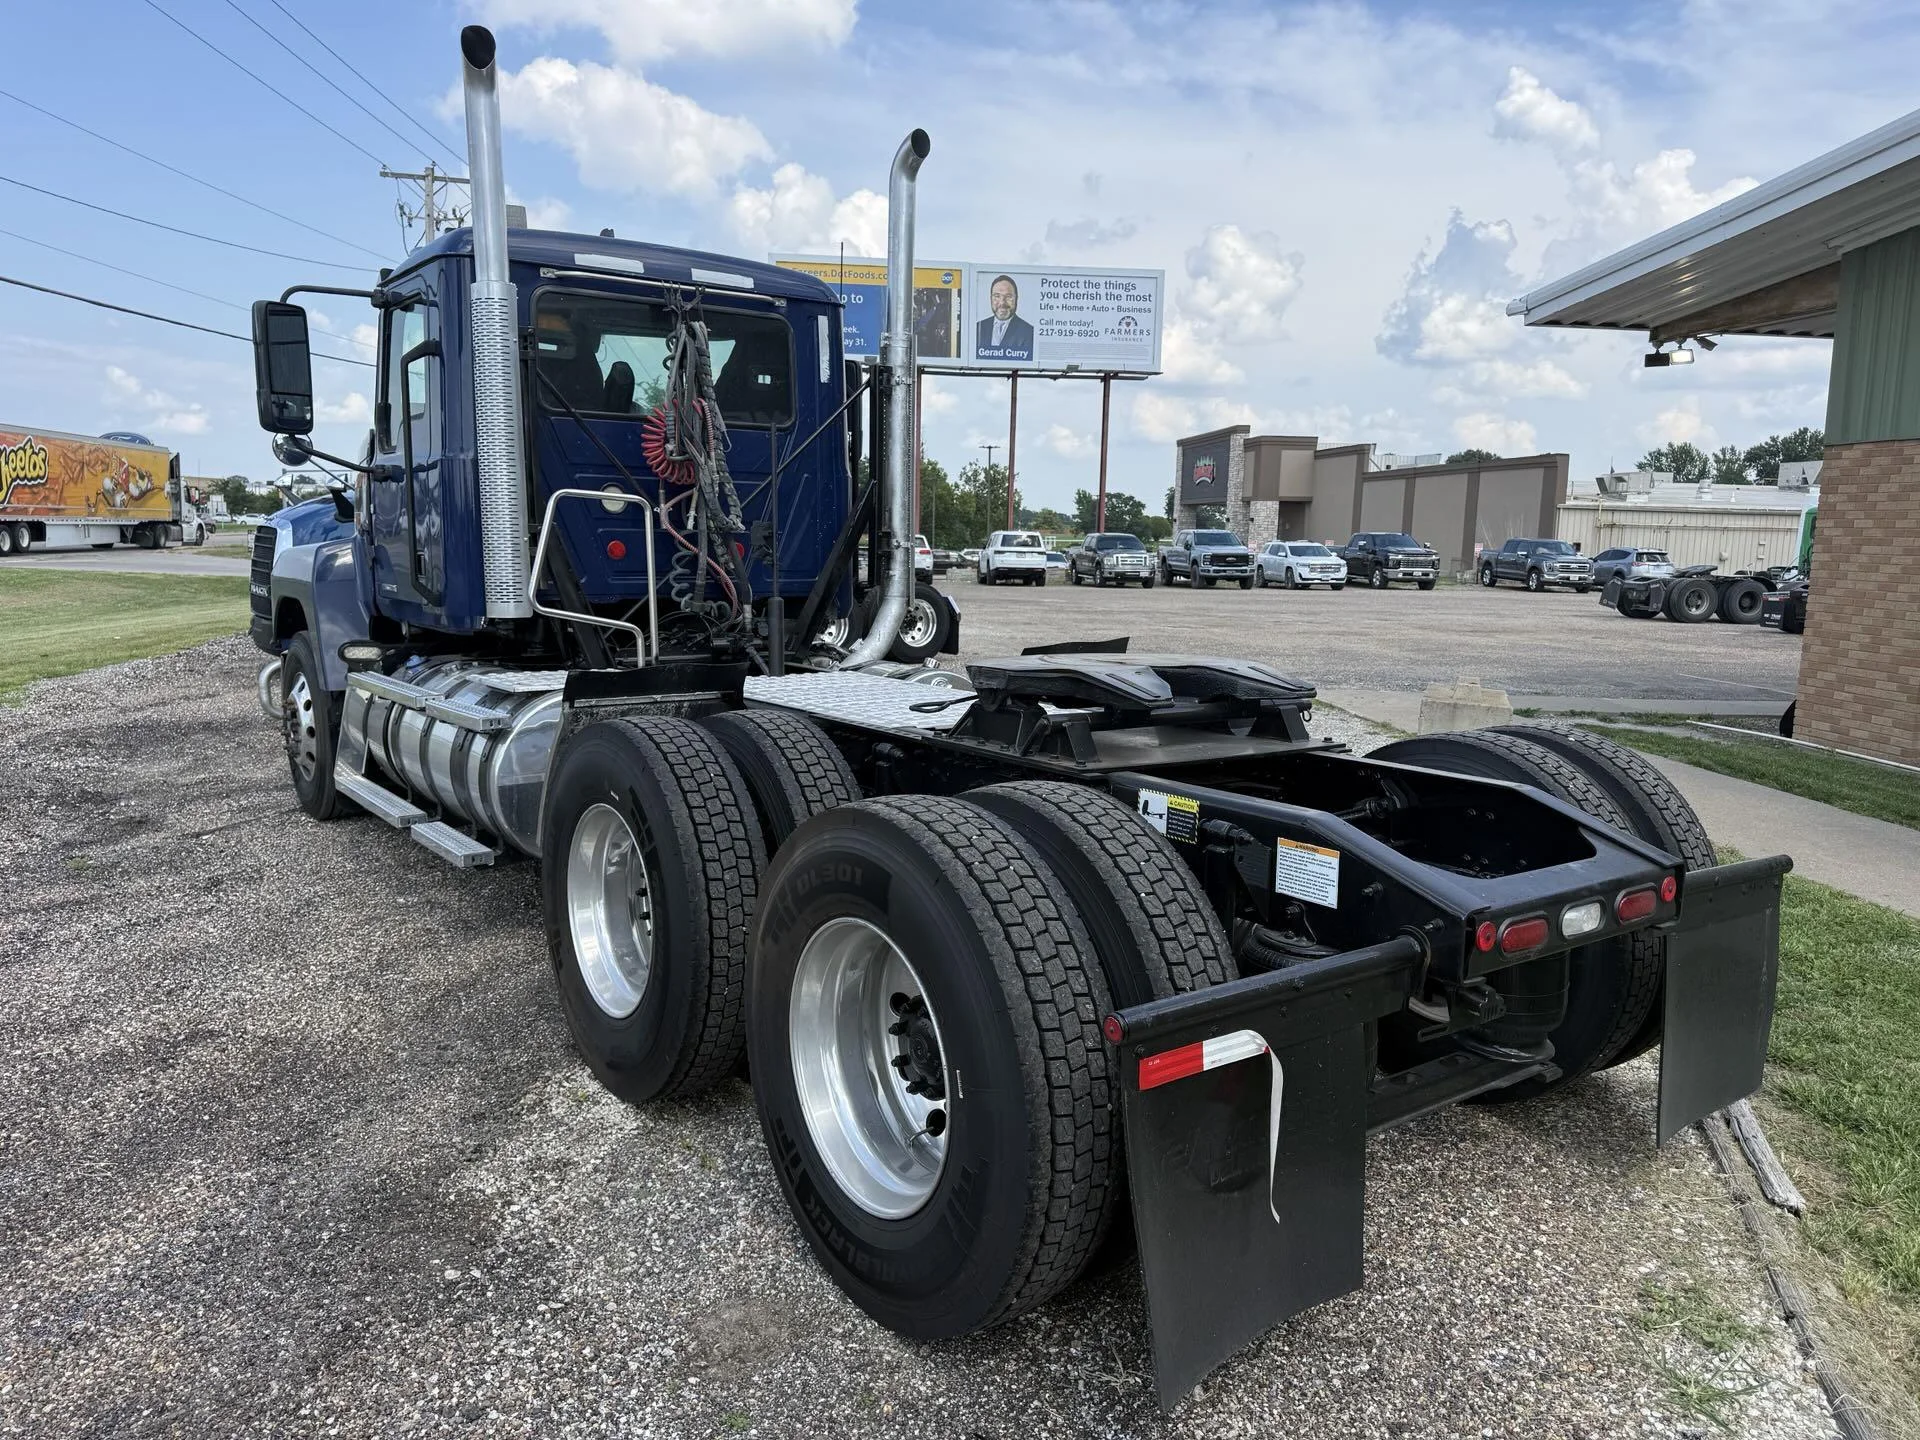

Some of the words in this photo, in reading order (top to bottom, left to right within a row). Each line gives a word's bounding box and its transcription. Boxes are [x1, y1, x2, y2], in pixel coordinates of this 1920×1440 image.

[1040, 278, 1080, 289] Protect
[1084, 279, 1101, 290] the
[1104, 280, 1137, 292] things
[851, 293, 864, 304] to
[1040, 291, 1059, 301] you
[1063, 290, 1101, 301] cherish
[1105, 291, 1122, 301] the
[1126, 293, 1152, 302] most
[1039, 303, 1054, 311] Life
[1061, 304, 1084, 312] Home
[1091, 304, 1110, 312] Auto
[1117, 305, 1152, 313] Business
[1039, 318, 1054, 326] Call
[1069, 319, 1094, 328] today!
[843, 325, 860, 333] eek.
[1039, 328, 1100, 337] 217-919-6920
[1104, 328, 1151, 336] FARMERS
[843, 338, 854, 347] ay
[855, 338, 867, 346] 31.
[978, 348, 1004, 357] Gerad
[1005, 349, 1029, 359] Curry
[0, 438, 47, 502] heetos
